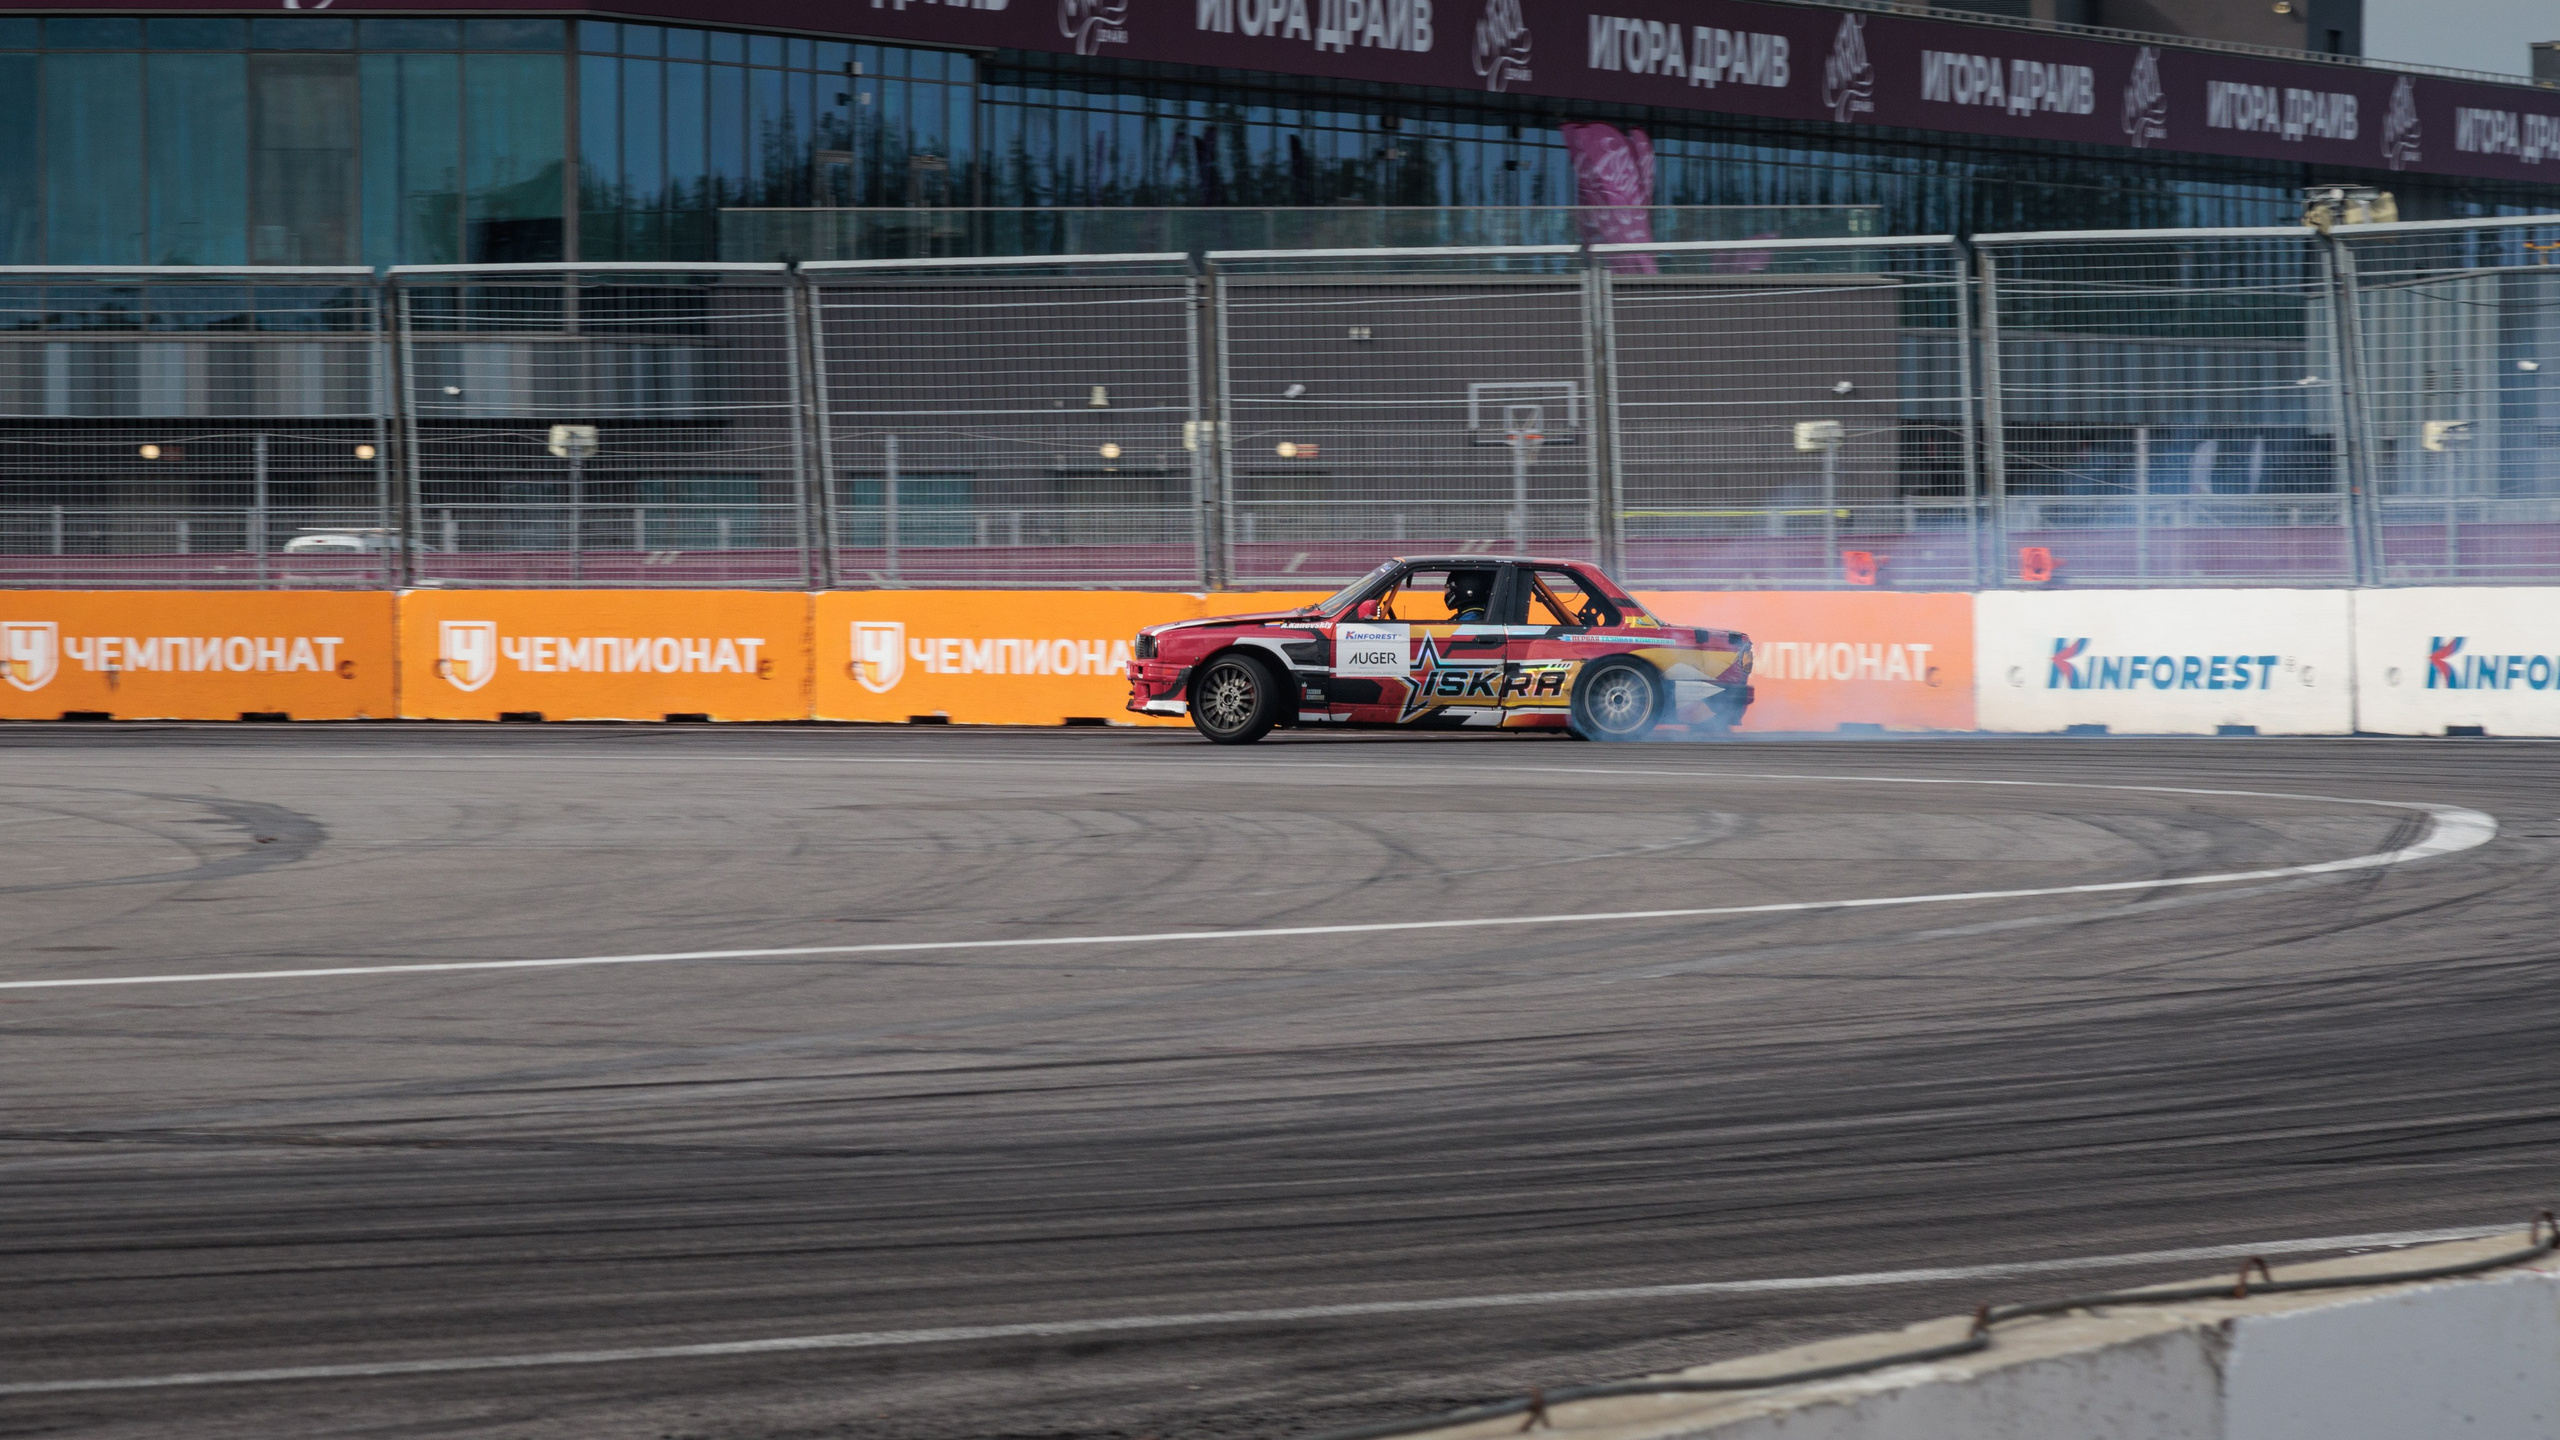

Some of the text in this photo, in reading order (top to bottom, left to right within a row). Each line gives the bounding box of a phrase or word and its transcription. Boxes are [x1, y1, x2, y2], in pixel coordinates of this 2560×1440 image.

[1588, 14, 1688, 77] ИГОРА
[1920, 49, 2006, 107] ИГОРА
[2206, 80, 2281, 133] ИГОРА
[2455, 107, 2520, 155] ИГОРА
[63, 636, 345, 672] ЧЕМПИОНАТ
[501, 636, 766, 673] ЧЕМПИОНАТ
[1345, 630, 1397, 640] KINFOREST
[909, 637, 1137, 676] ЧЕМПИОНА
[1349, 651, 1397, 665] AUGER
[1753, 641, 1934, 682] МПИОНАТ
[2047, 636, 2281, 690] KINFOREST
[2424, 635, 2560, 690] KINFO
[1422, 671, 1567, 697] ISKRA
